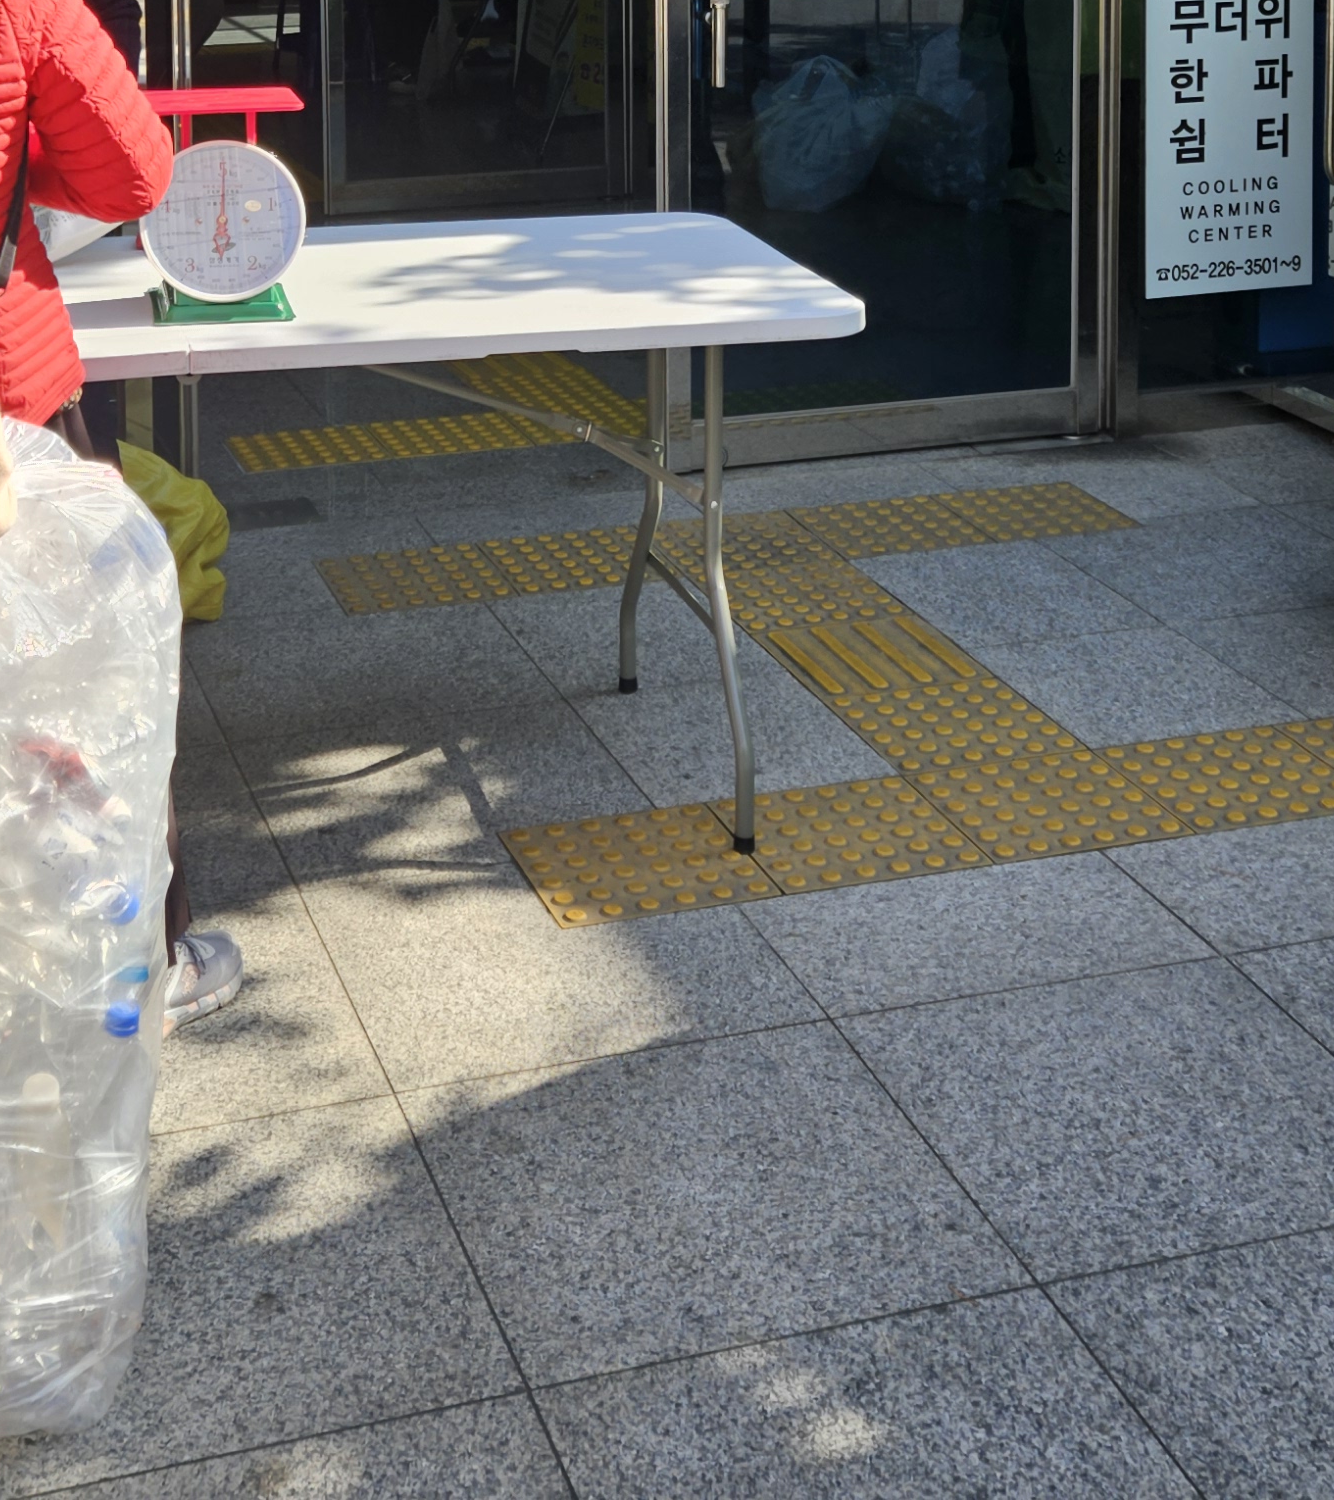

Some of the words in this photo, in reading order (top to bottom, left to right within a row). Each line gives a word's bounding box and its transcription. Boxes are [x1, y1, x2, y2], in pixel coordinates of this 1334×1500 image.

[1182, 176, 1279, 196] COOLING
[1180, 200, 1280, 220] WARMING
[1188, 224, 1273, 243] CENTER
